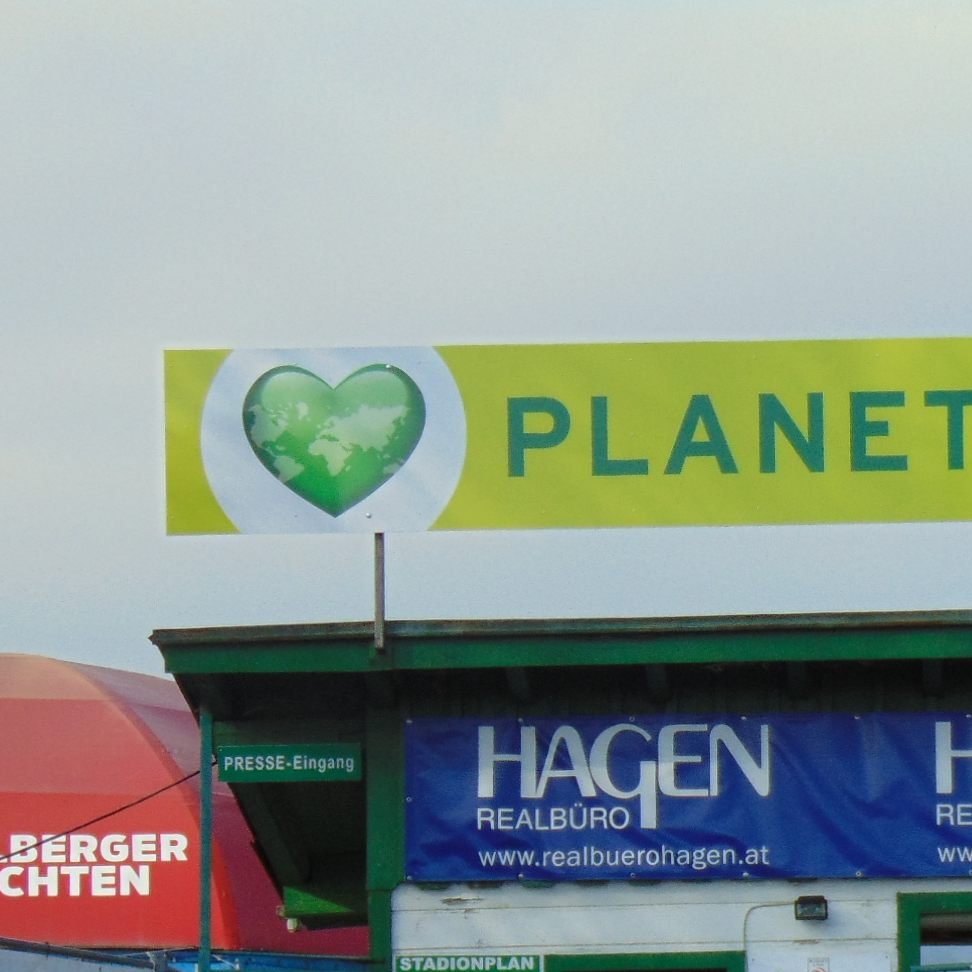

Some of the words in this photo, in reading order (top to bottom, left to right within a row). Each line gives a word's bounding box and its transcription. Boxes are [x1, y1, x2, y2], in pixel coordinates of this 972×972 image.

[224, 755, 354, 773] PRESSE-Eingang
[477, 723, 770, 829] HAGEN
[477, 803, 631, 830] REALBÜRO
[0, 834, 189, 863] BERGER
[478, 845, 770, 870] www.realbuerohagen.at
[0, 866, 150, 897] CHTEN
[400, 956, 534, 971] STADIONPLAN
